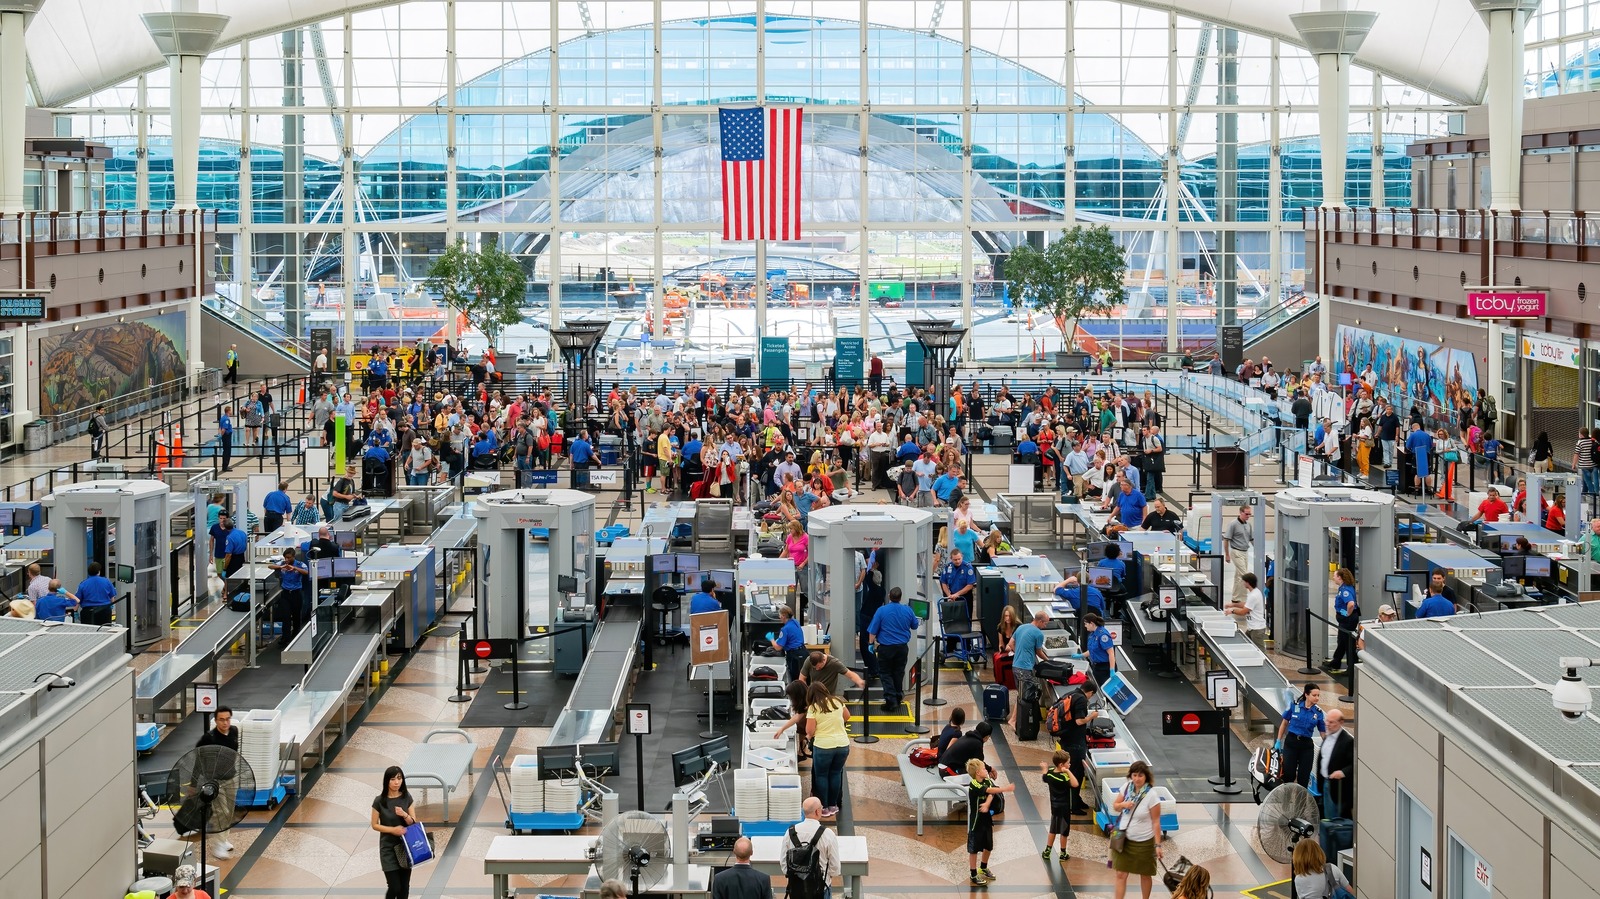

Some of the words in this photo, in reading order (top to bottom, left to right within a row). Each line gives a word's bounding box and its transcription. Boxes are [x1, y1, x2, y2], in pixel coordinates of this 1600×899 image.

[1516, 296, 1539, 305] frozen
[1, 307, 41, 316] STORAGE
[1516, 304, 1539, 312] yogurt
[1476, 866, 1489, 887] EXIT
